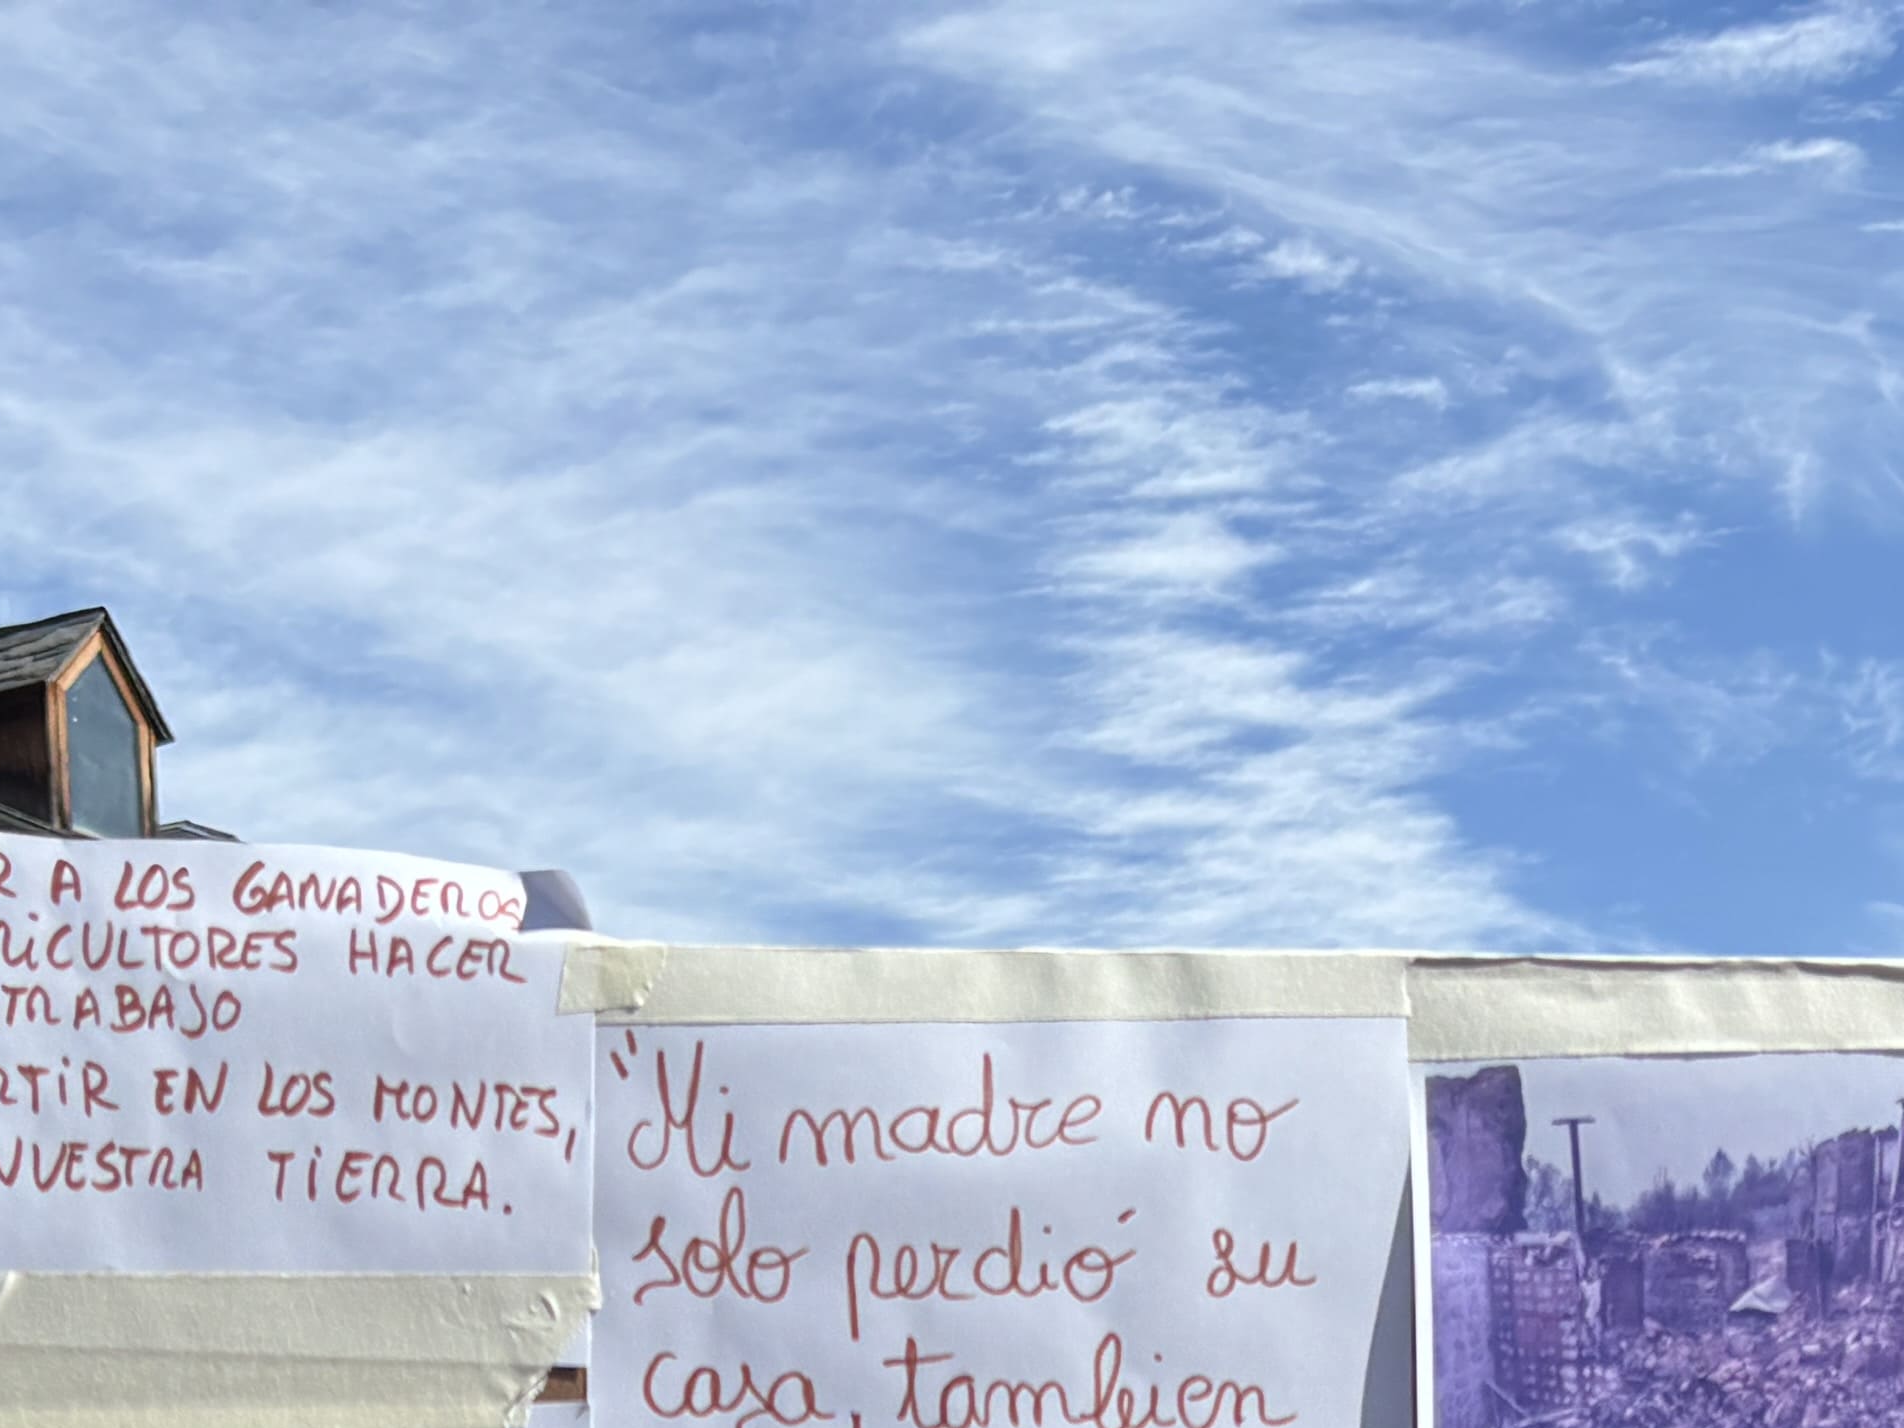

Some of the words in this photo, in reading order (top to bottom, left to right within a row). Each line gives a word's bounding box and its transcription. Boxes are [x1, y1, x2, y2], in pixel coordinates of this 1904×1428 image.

[50, 859, 83, 906] A
[114, 862, 196, 912] LOS
[348, 929, 527, 985] HACER
[1, 984, 242, 1040] TRABAJO
[154, 1062, 228, 1116] EN
[257, 1063, 336, 1118] LOS
[779, 1052, 1104, 1167] madre
[1145, 1091, 1296, 1162] no
[633, 1185, 807, 1306] solo
[846, 1206, 1136, 1343] perdió
[1206, 1228, 1317, 1299] su
